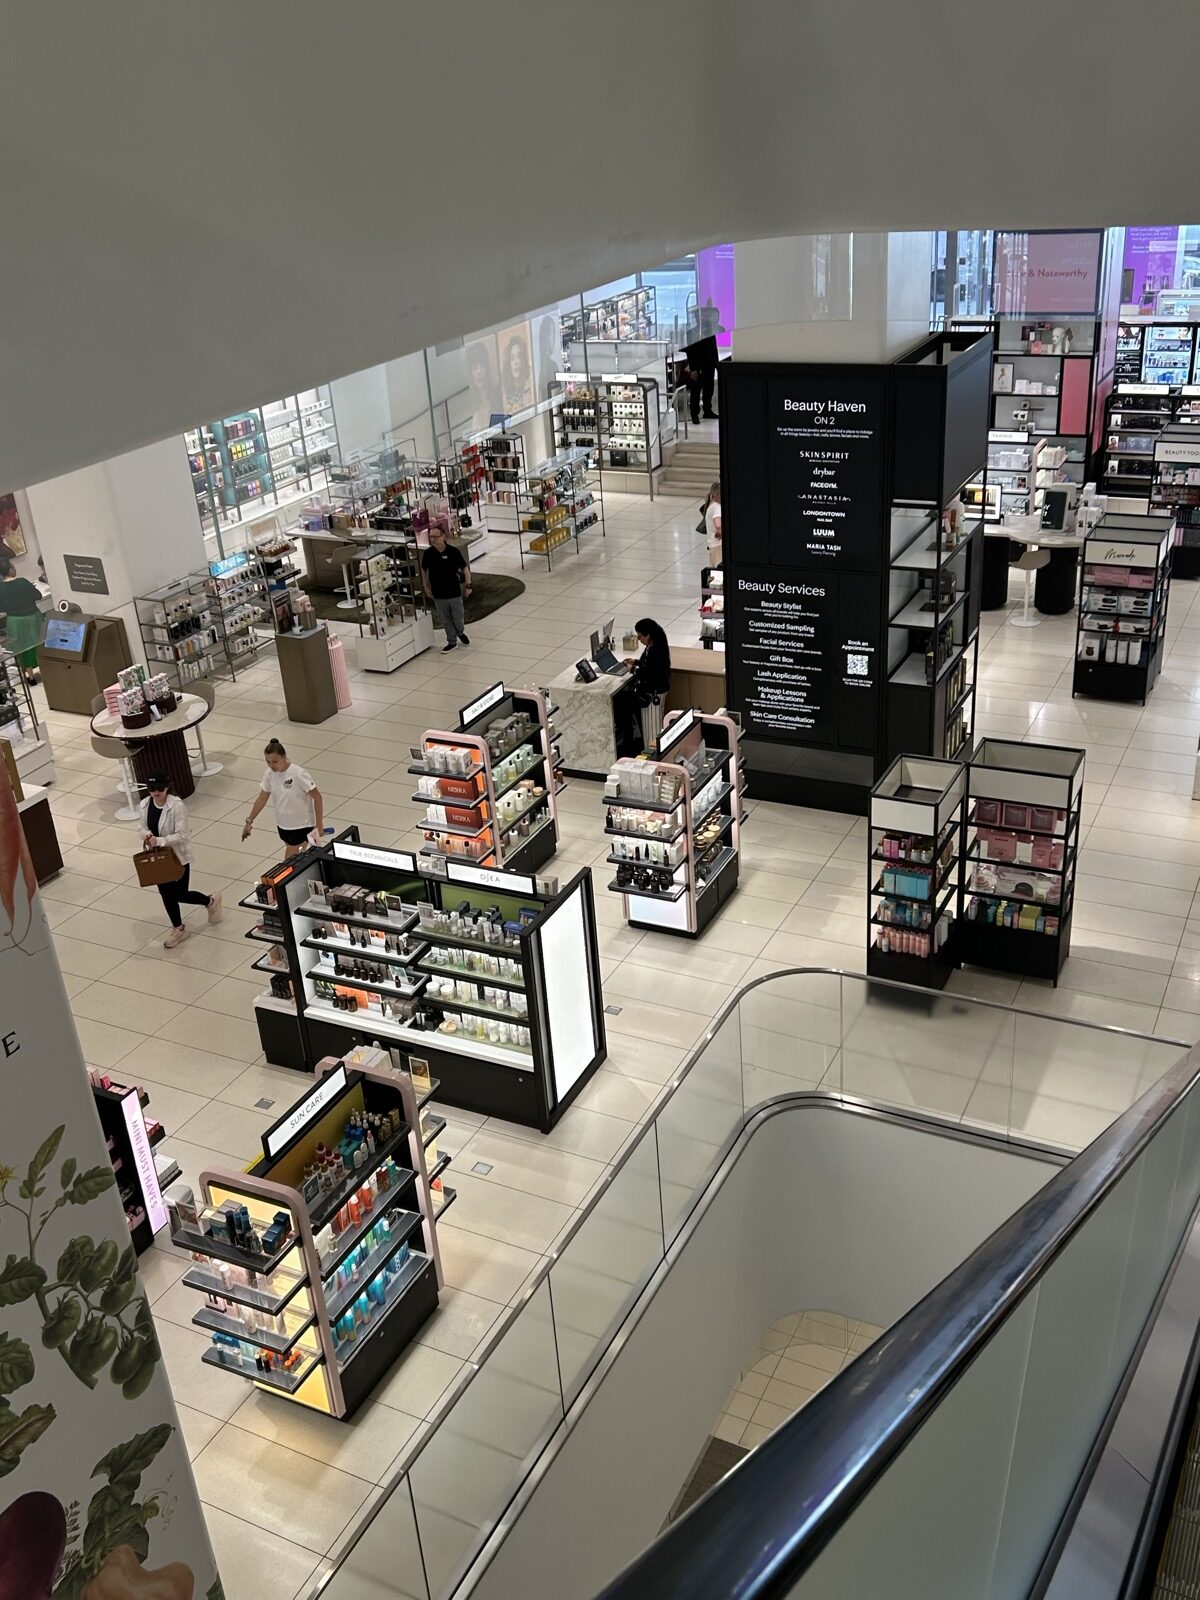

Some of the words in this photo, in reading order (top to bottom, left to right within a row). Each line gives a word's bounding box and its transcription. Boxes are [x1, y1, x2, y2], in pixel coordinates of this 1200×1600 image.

[1028, 269, 1034, 278] &
[1037, 268, 1088, 280] Noteworthy
[784, 399, 825, 414] Beauty
[828, 400, 866, 413] Haven
[814, 416, 828, 425] ON
[829, 416, 835, 425] 2
[813, 467, 836, 478] drybar
[738, 579, 776, 594] Beauty
[778, 582, 825, 597] Services
[761, 601, 782, 609] Beauty
[749, 620, 785, 629] Customized
[786, 623, 815, 633] Sampling
[778, 639, 804, 648] Services
[842, 644, 874, 652] Appointment
[772, 672, 807, 681] Application
[758, 686, 781, 694] Makeup
[782, 688, 807, 697] Lessons
[767, 693, 804, 703] Applications
[778, 714, 815, 724] Consultation
[480, 873, 500, 883] OSEA
[290, 1110, 305, 1129] SUN
[305, 1091, 325, 1113] CARE
[131, 1119, 143, 1145] MINI
[137, 1145, 150, 1174] MUST
[144, 1174, 158, 1209] HAVES
